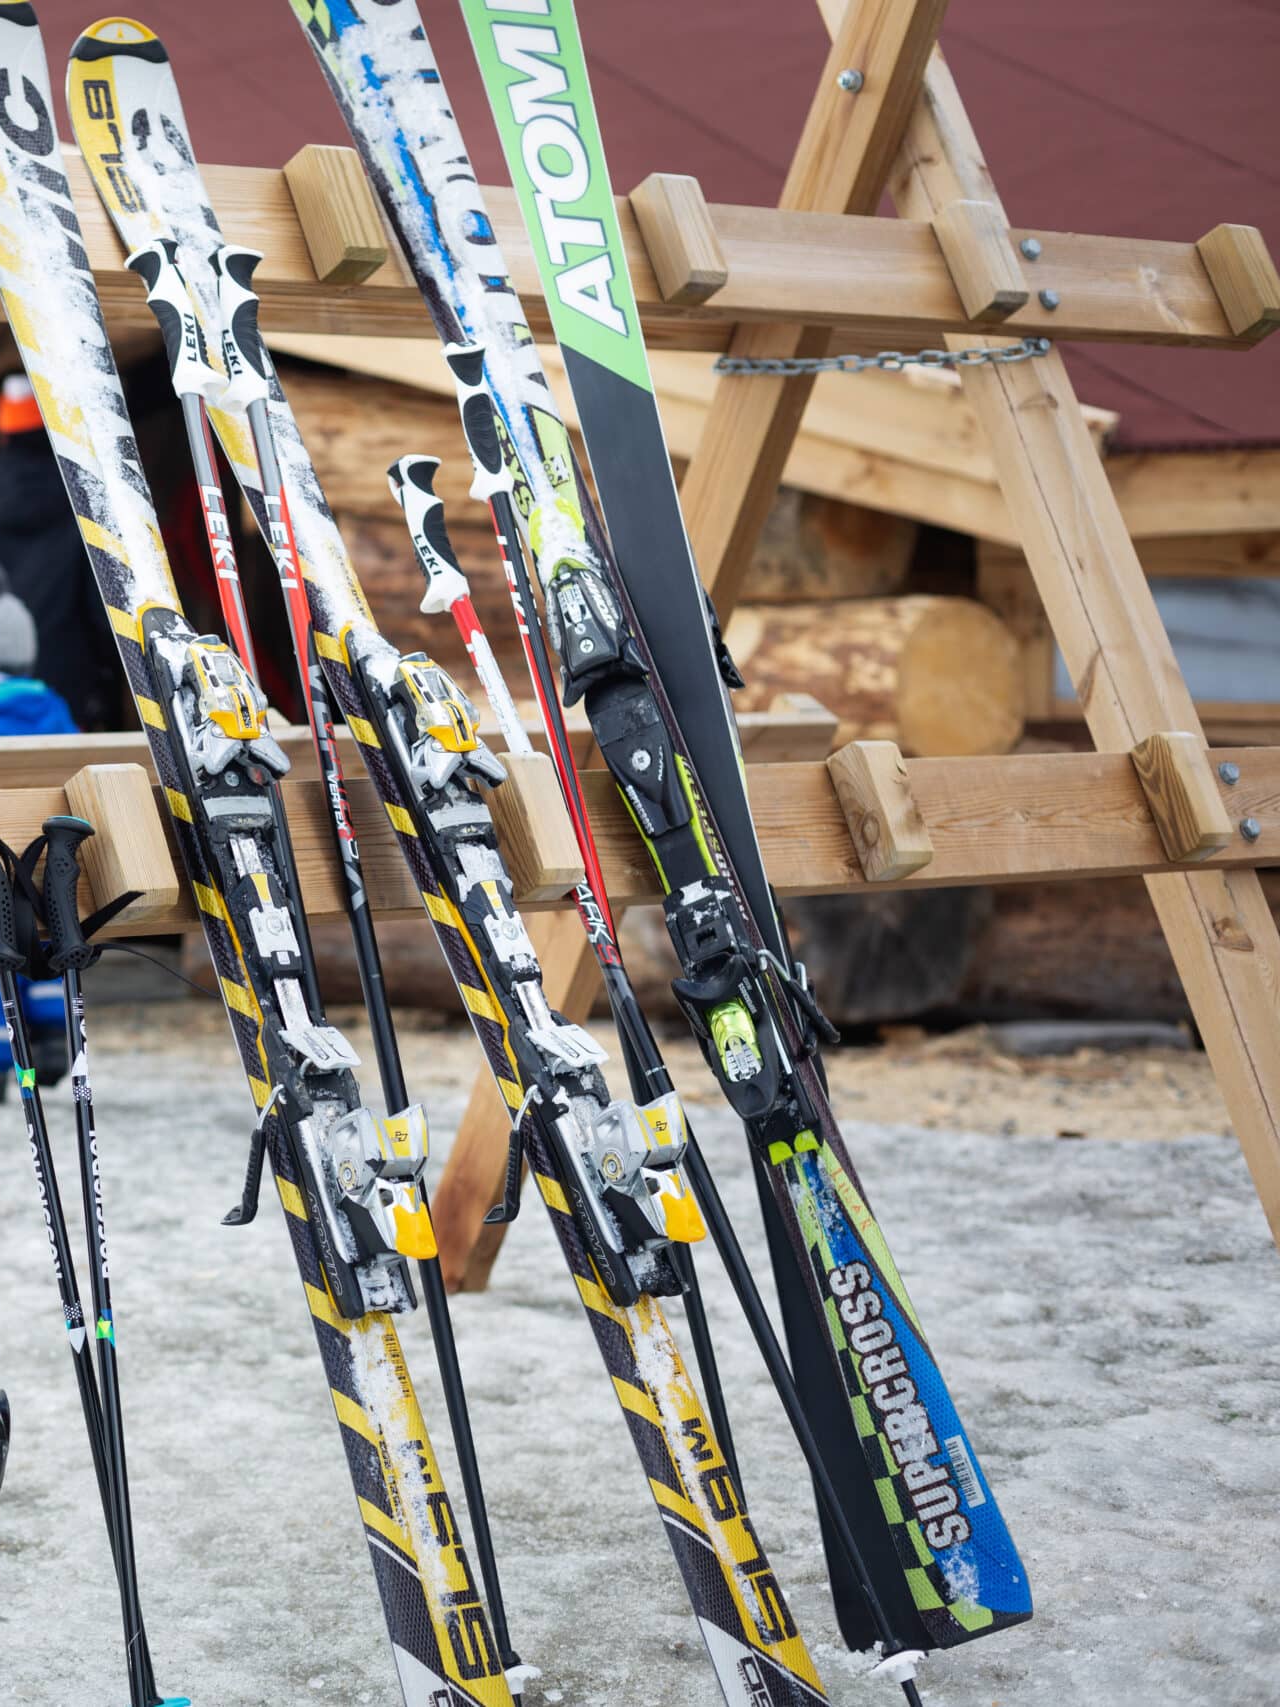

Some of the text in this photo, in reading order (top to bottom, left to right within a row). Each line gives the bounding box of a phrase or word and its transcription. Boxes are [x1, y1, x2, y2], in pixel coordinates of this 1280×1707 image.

[185, 312, 198, 362] LEKI
[222, 329, 243, 375] LEKI
[200, 485, 239, 581] LEKI
[263, 495, 298, 590] LEKI
[414, 534, 443, 576] LEKI
[327, 773, 346, 831] VERTEX
[827, 1260, 970, 1551] SUPERCROSS
